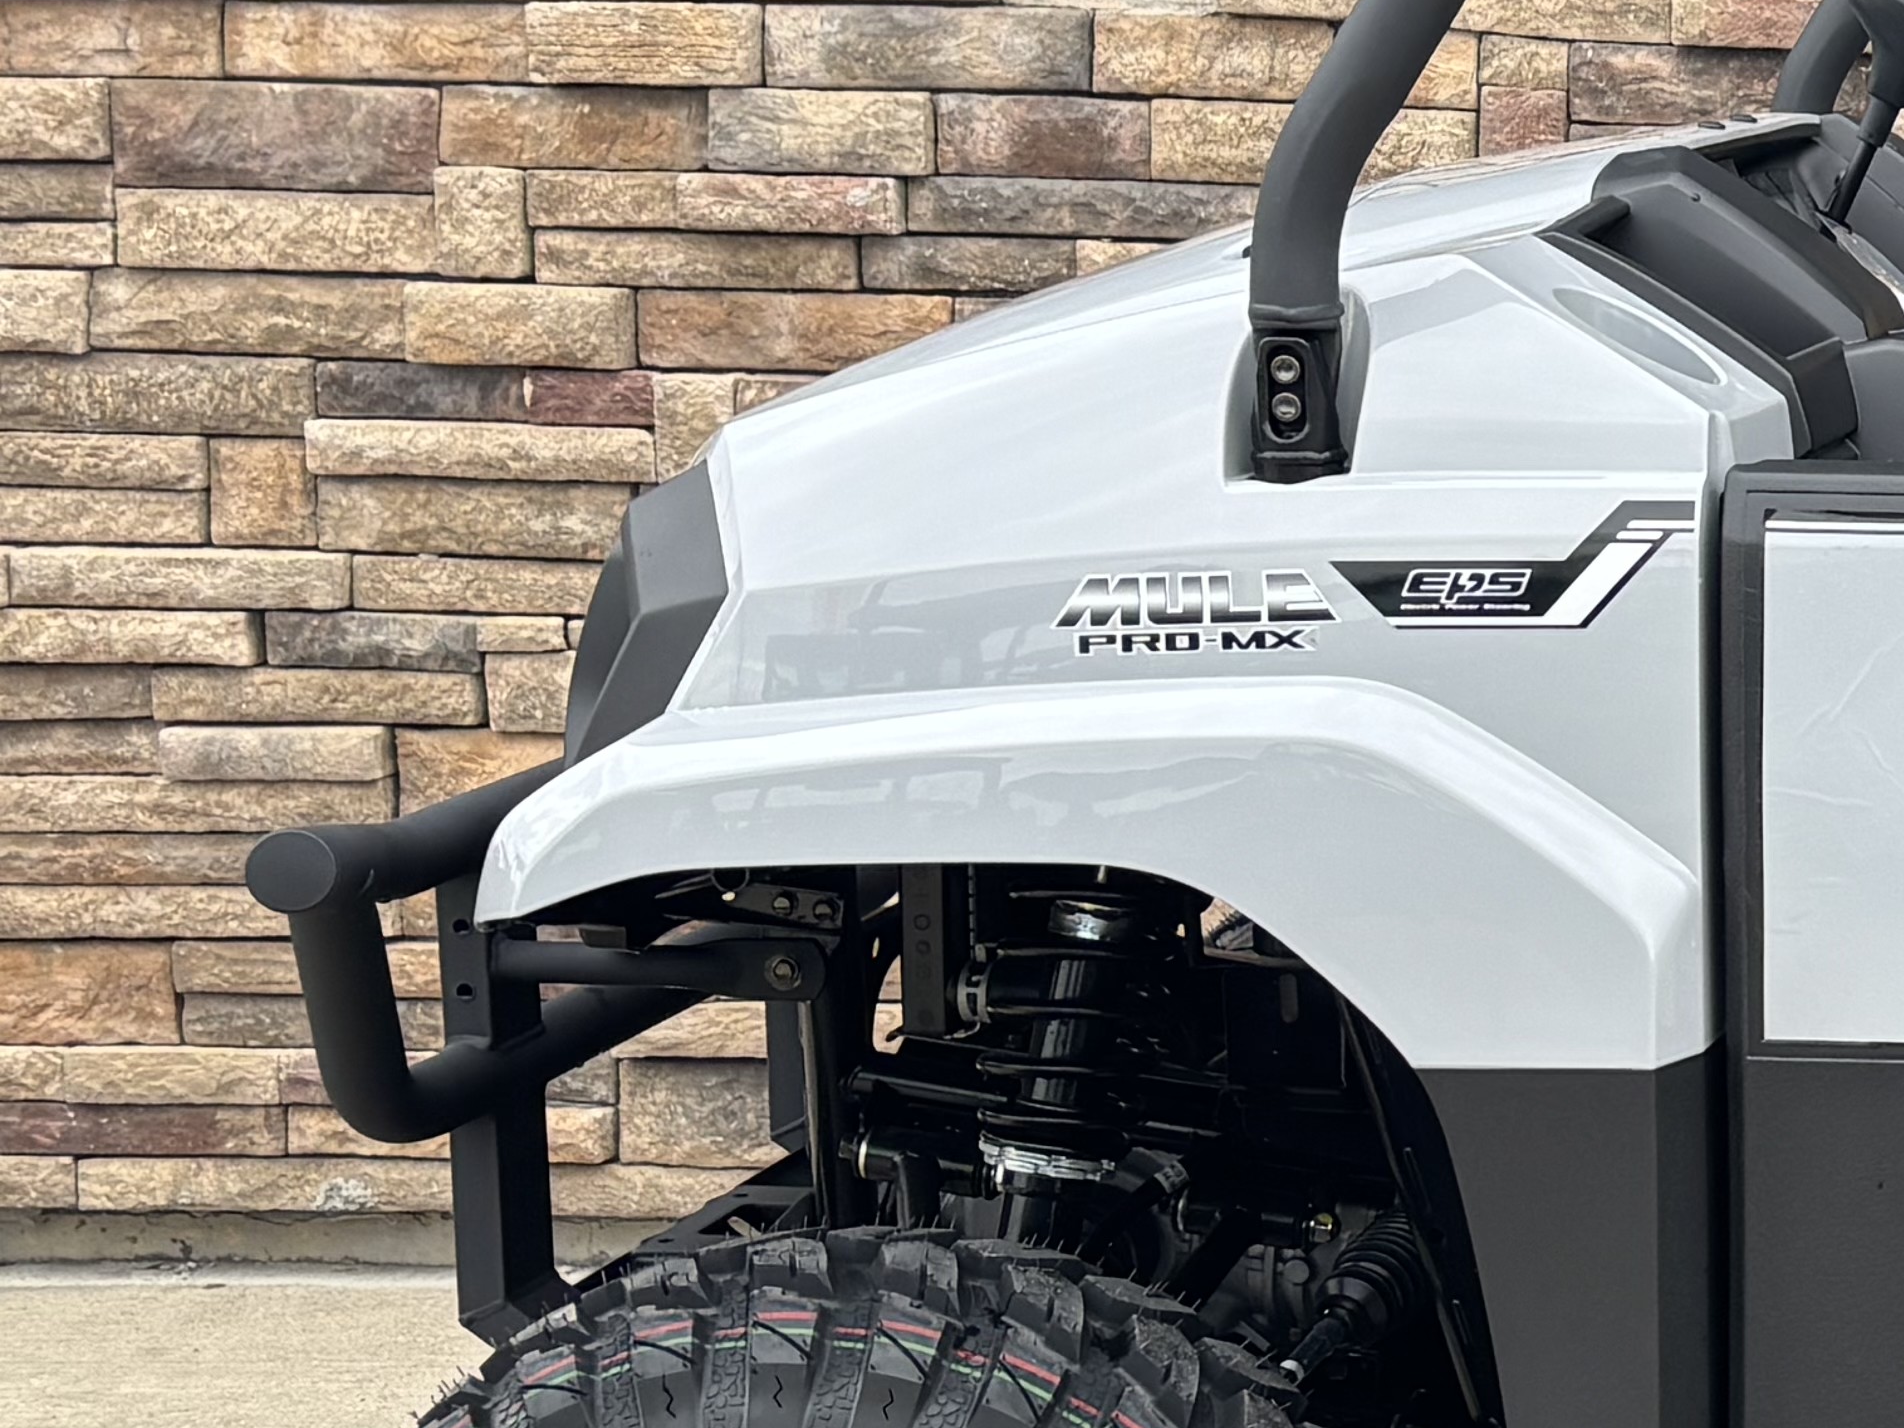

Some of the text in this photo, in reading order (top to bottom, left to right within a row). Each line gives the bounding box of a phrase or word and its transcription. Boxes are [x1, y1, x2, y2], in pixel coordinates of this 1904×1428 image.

[1051, 568, 1341, 628] MULE
[1401, 568, 1533, 604] EPS
[1077, 627, 1306, 655] PRO-MX
